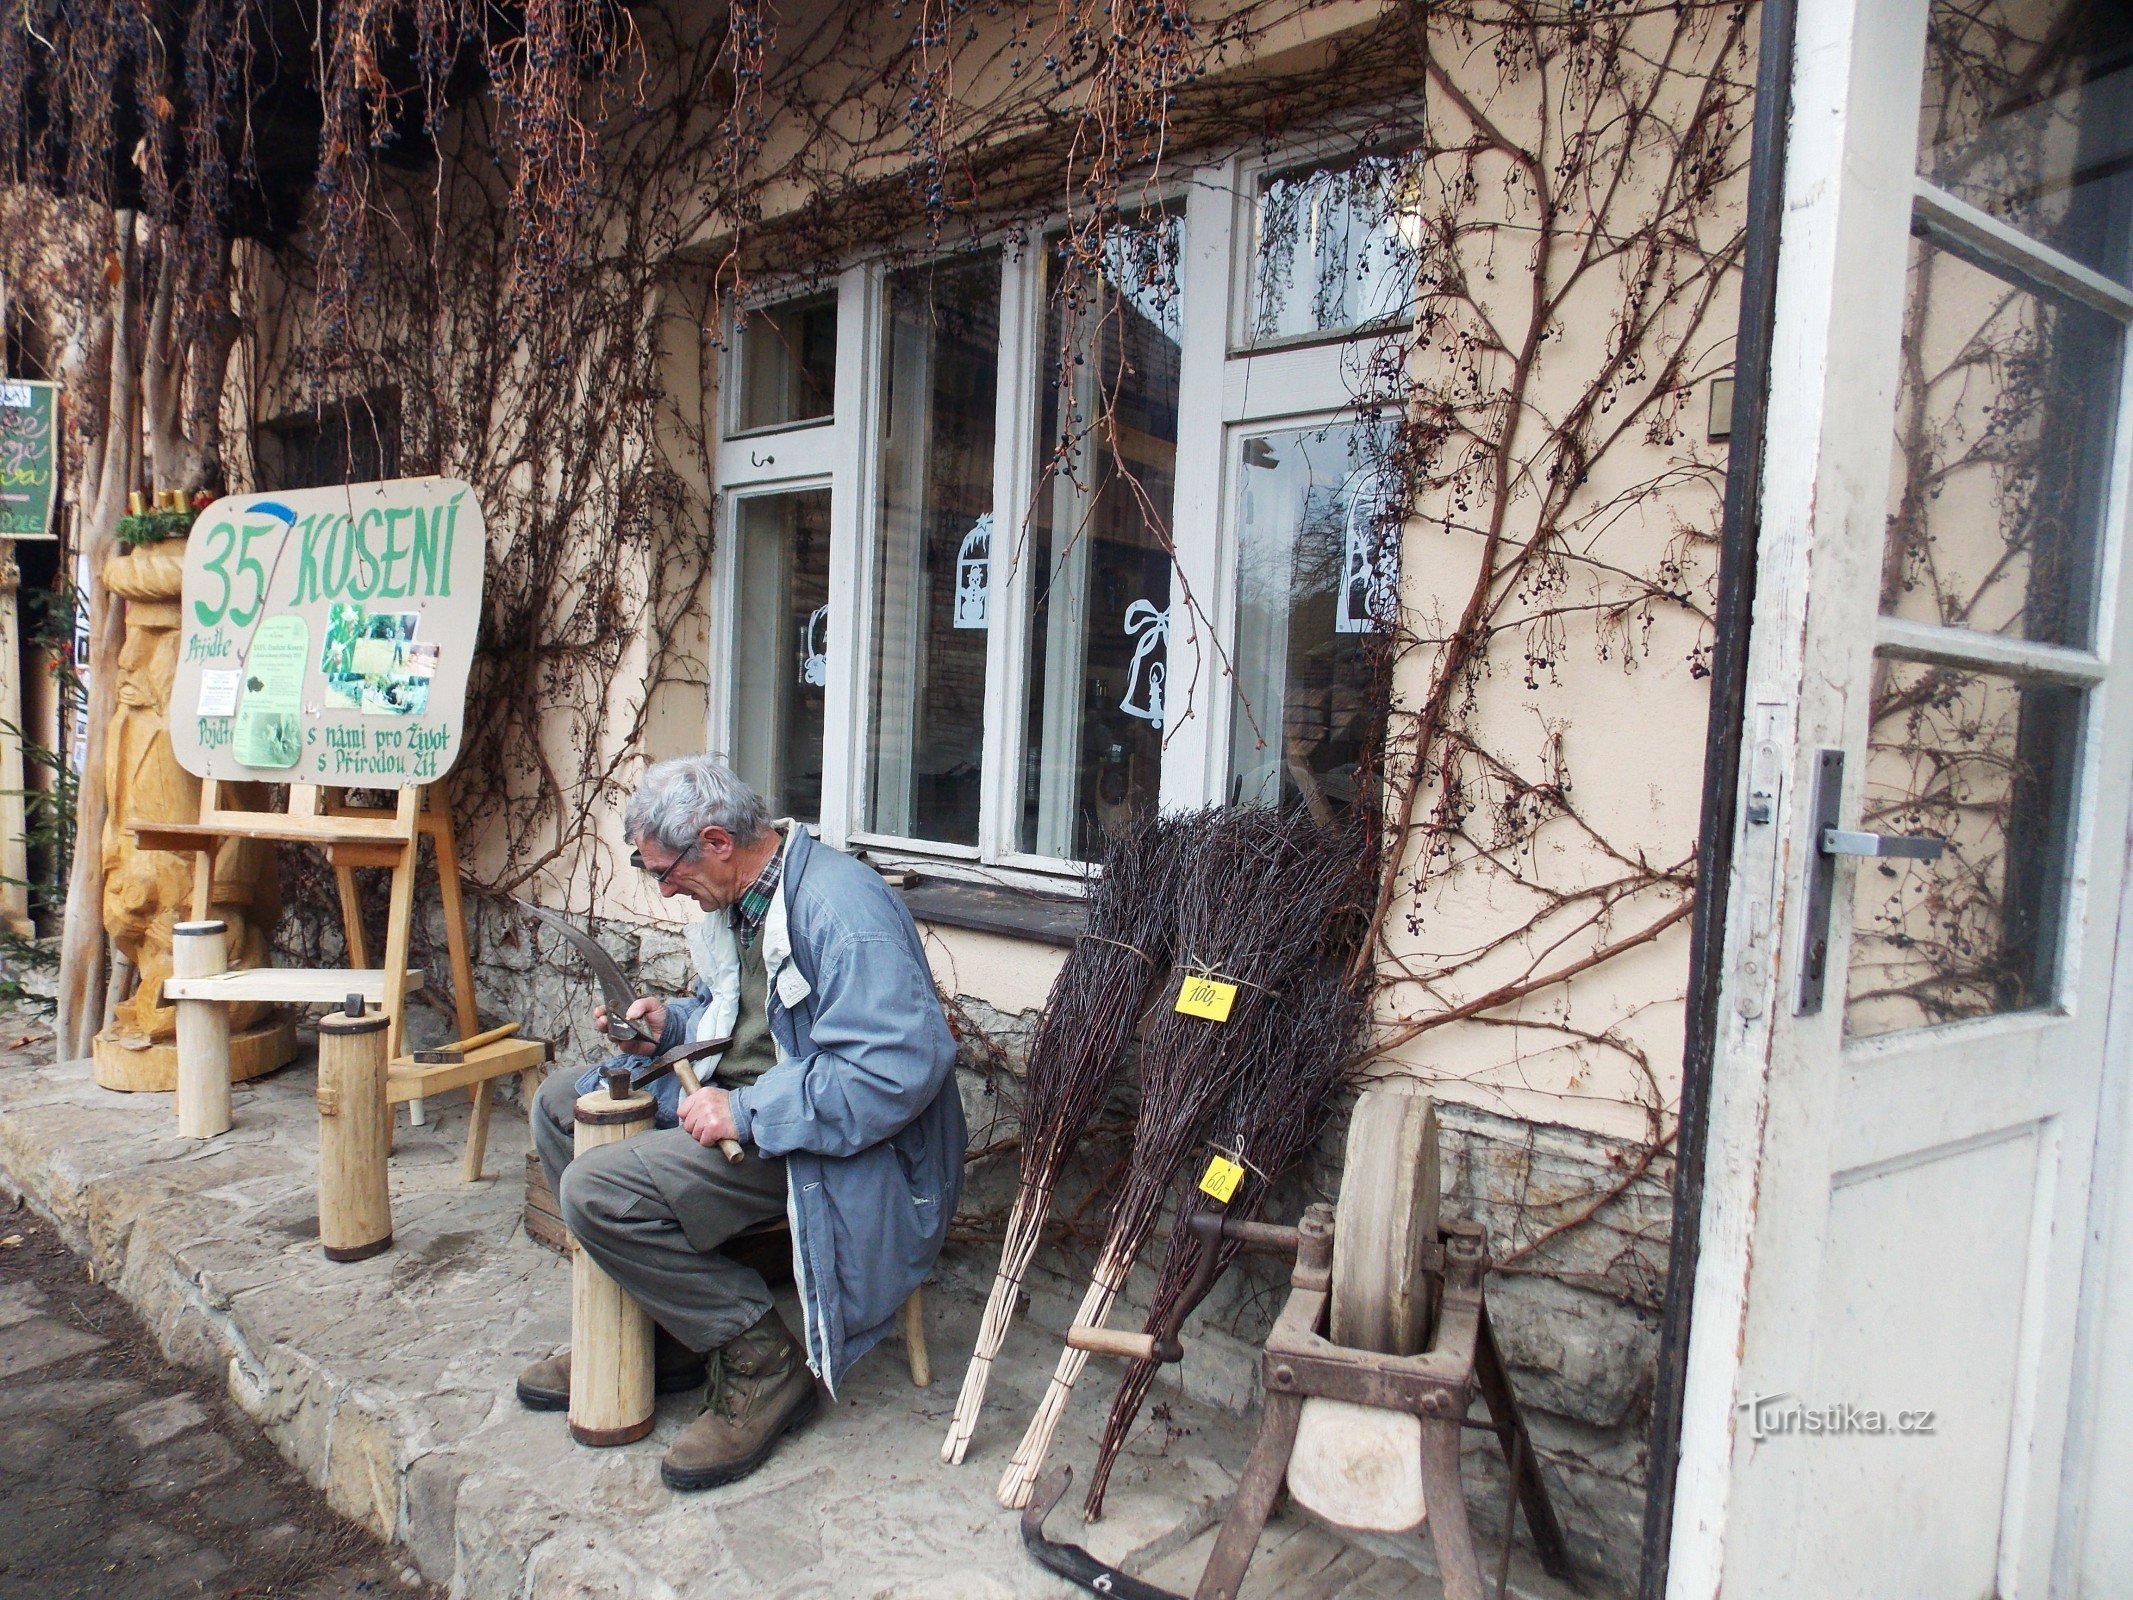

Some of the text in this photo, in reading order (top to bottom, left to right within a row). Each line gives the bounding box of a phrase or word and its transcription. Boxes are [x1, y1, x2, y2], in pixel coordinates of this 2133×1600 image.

[194, 488, 468, 627] 35 KOSENÍ
[307, 727, 316, 745] s
[326, 724, 366, 749] námi
[374, 730, 401, 752] pro
[407, 722, 450, 750] Život
[318, 753, 326, 772] s
[1188, 985, 1225, 1007] 100,-
[1206, 1171, 1230, 1195] 60,-
